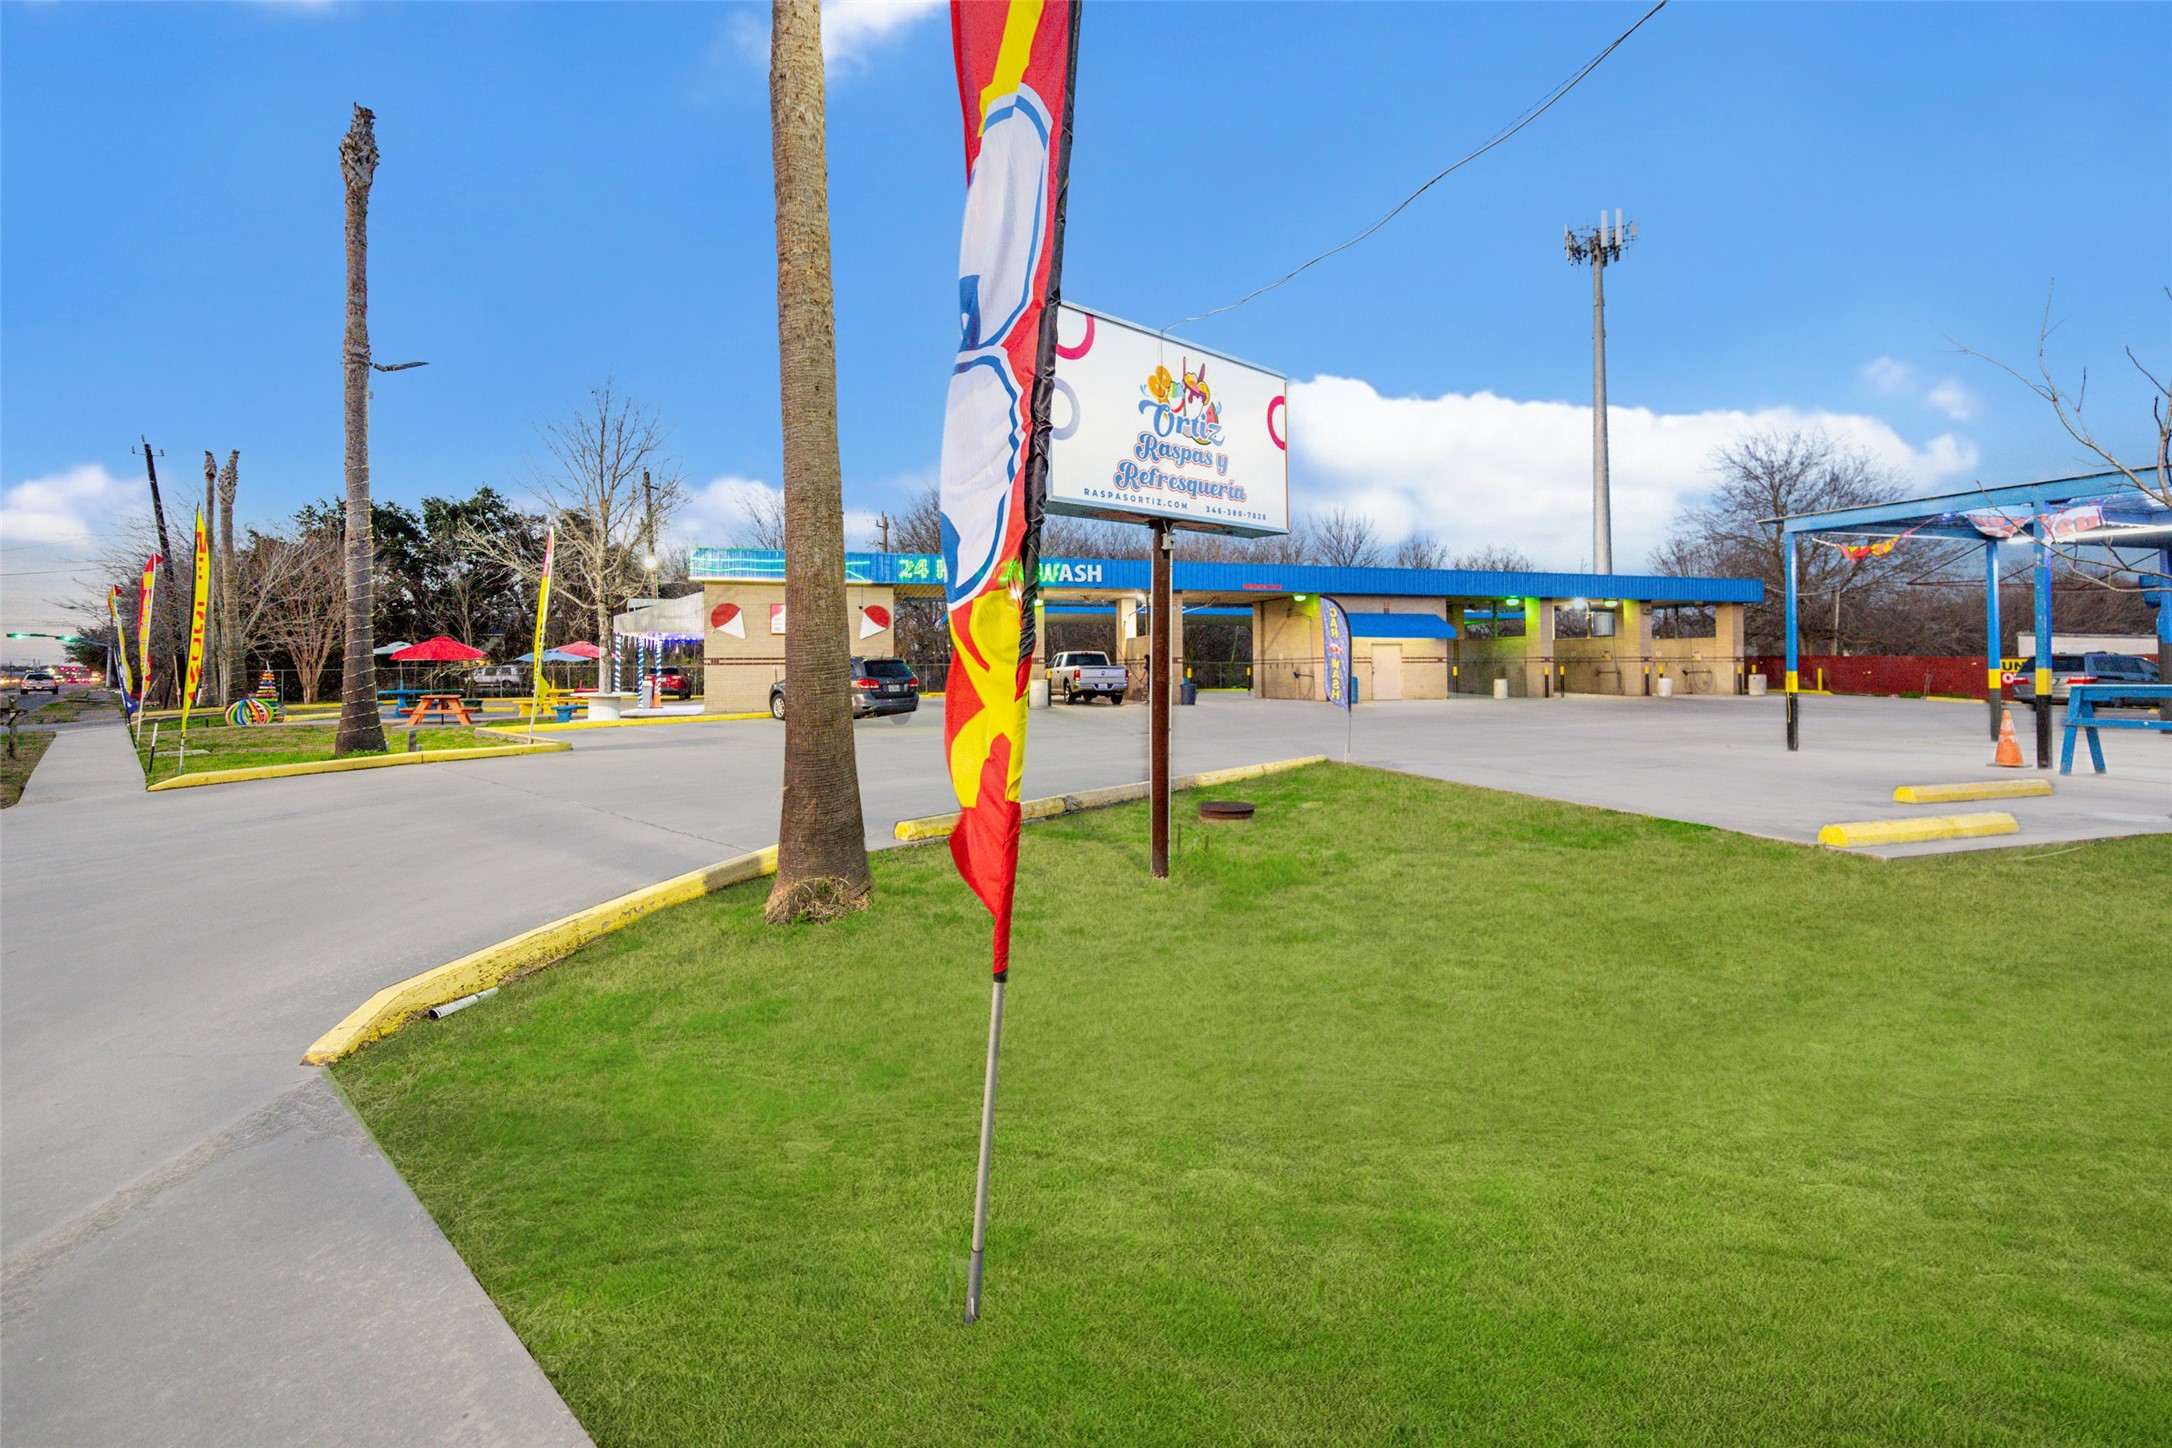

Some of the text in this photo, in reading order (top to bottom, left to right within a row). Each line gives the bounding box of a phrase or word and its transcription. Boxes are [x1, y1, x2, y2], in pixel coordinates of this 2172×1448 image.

[1138, 399, 1225, 447] Ortiz
[1135, 431, 1229, 476] Raspas y
[1084, 488, 1188, 510] RASPASORTIZ.COM
[1113, 459, 1247, 502] Refresquería
[898, 559, 930, 579] 24
[1039, 563, 1102, 582] WASH
